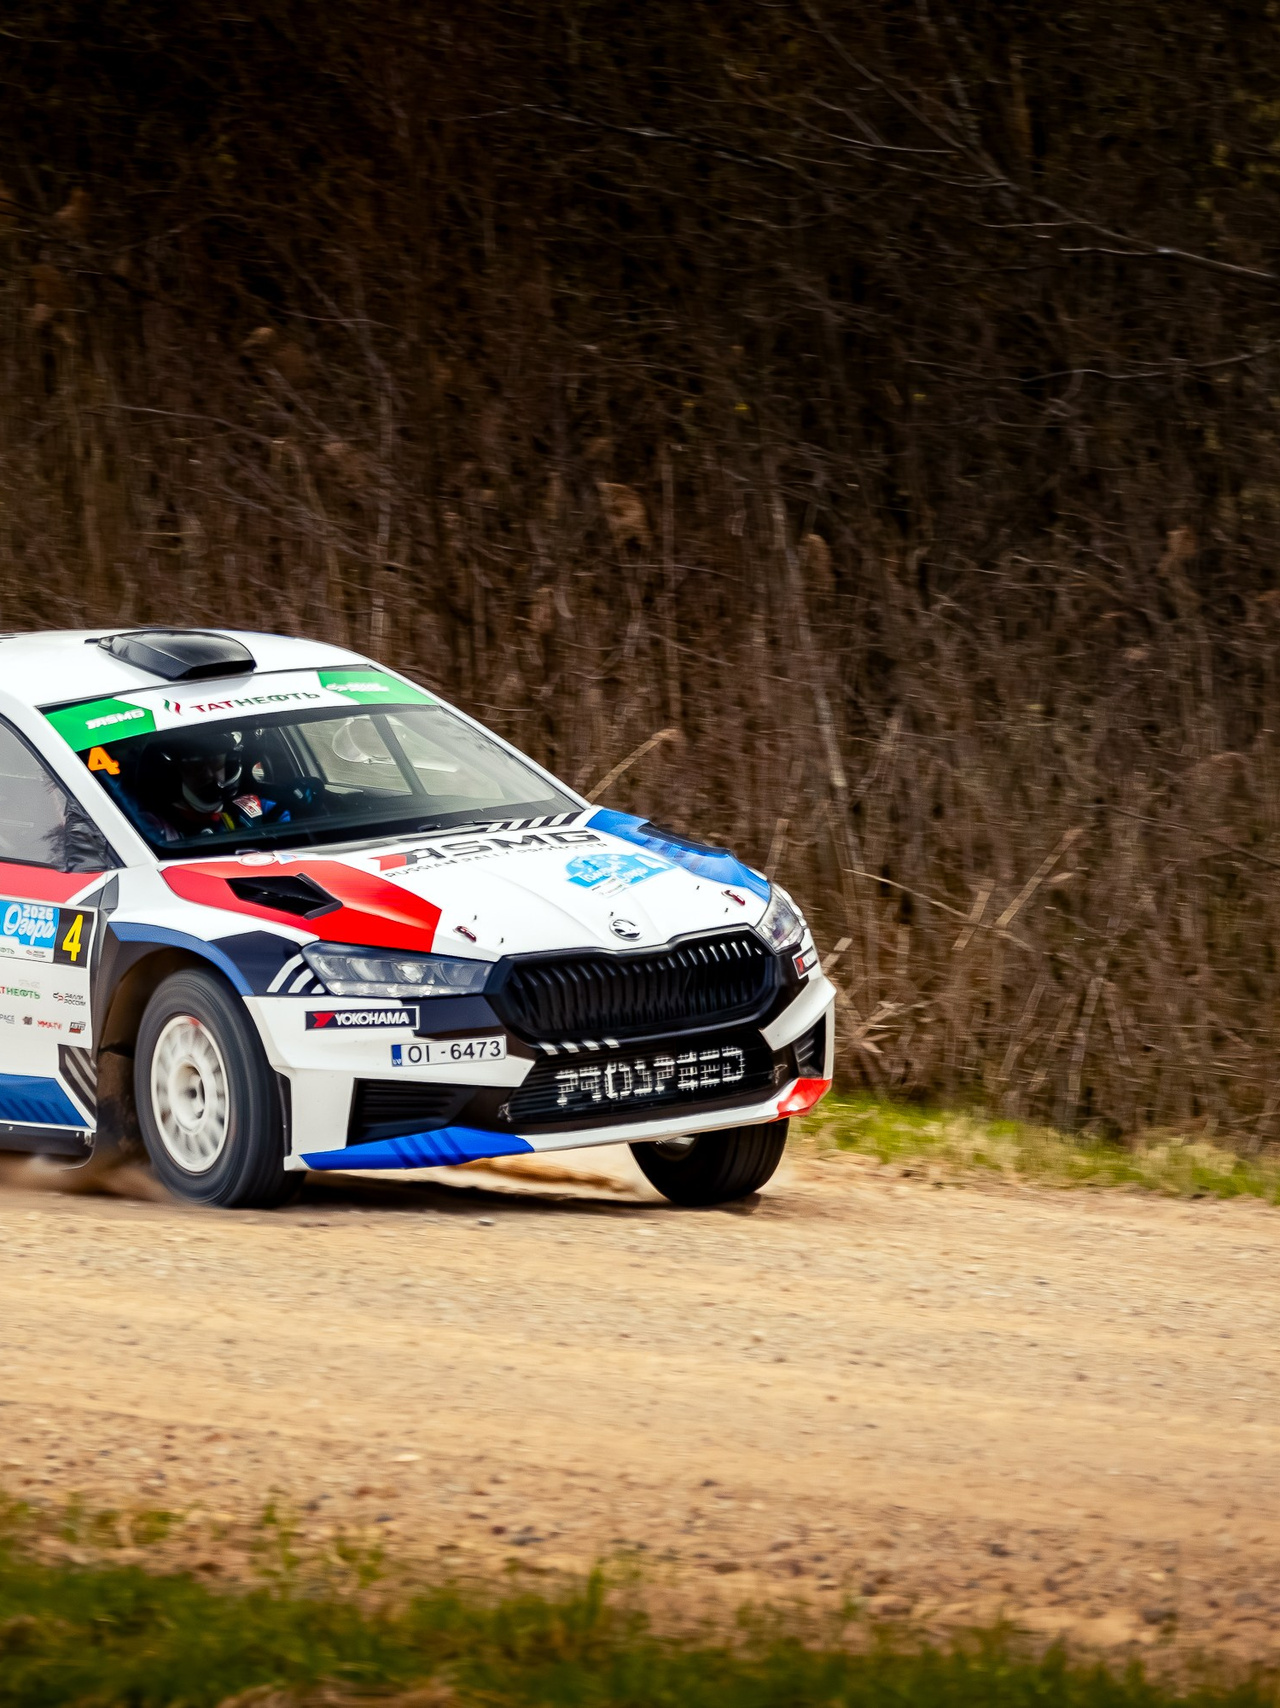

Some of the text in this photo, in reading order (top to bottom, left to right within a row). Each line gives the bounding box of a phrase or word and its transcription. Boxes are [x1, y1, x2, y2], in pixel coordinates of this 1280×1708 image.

[190, 691, 320, 713] ТАТНЕФТЬ
[87, 746, 121, 775] 4
[400, 829, 601, 866] ASMG
[22, 905, 54, 920] 2026
[62, 914, 84, 961] 4
[335, 1011, 410, 1026] YOKOHAMA
